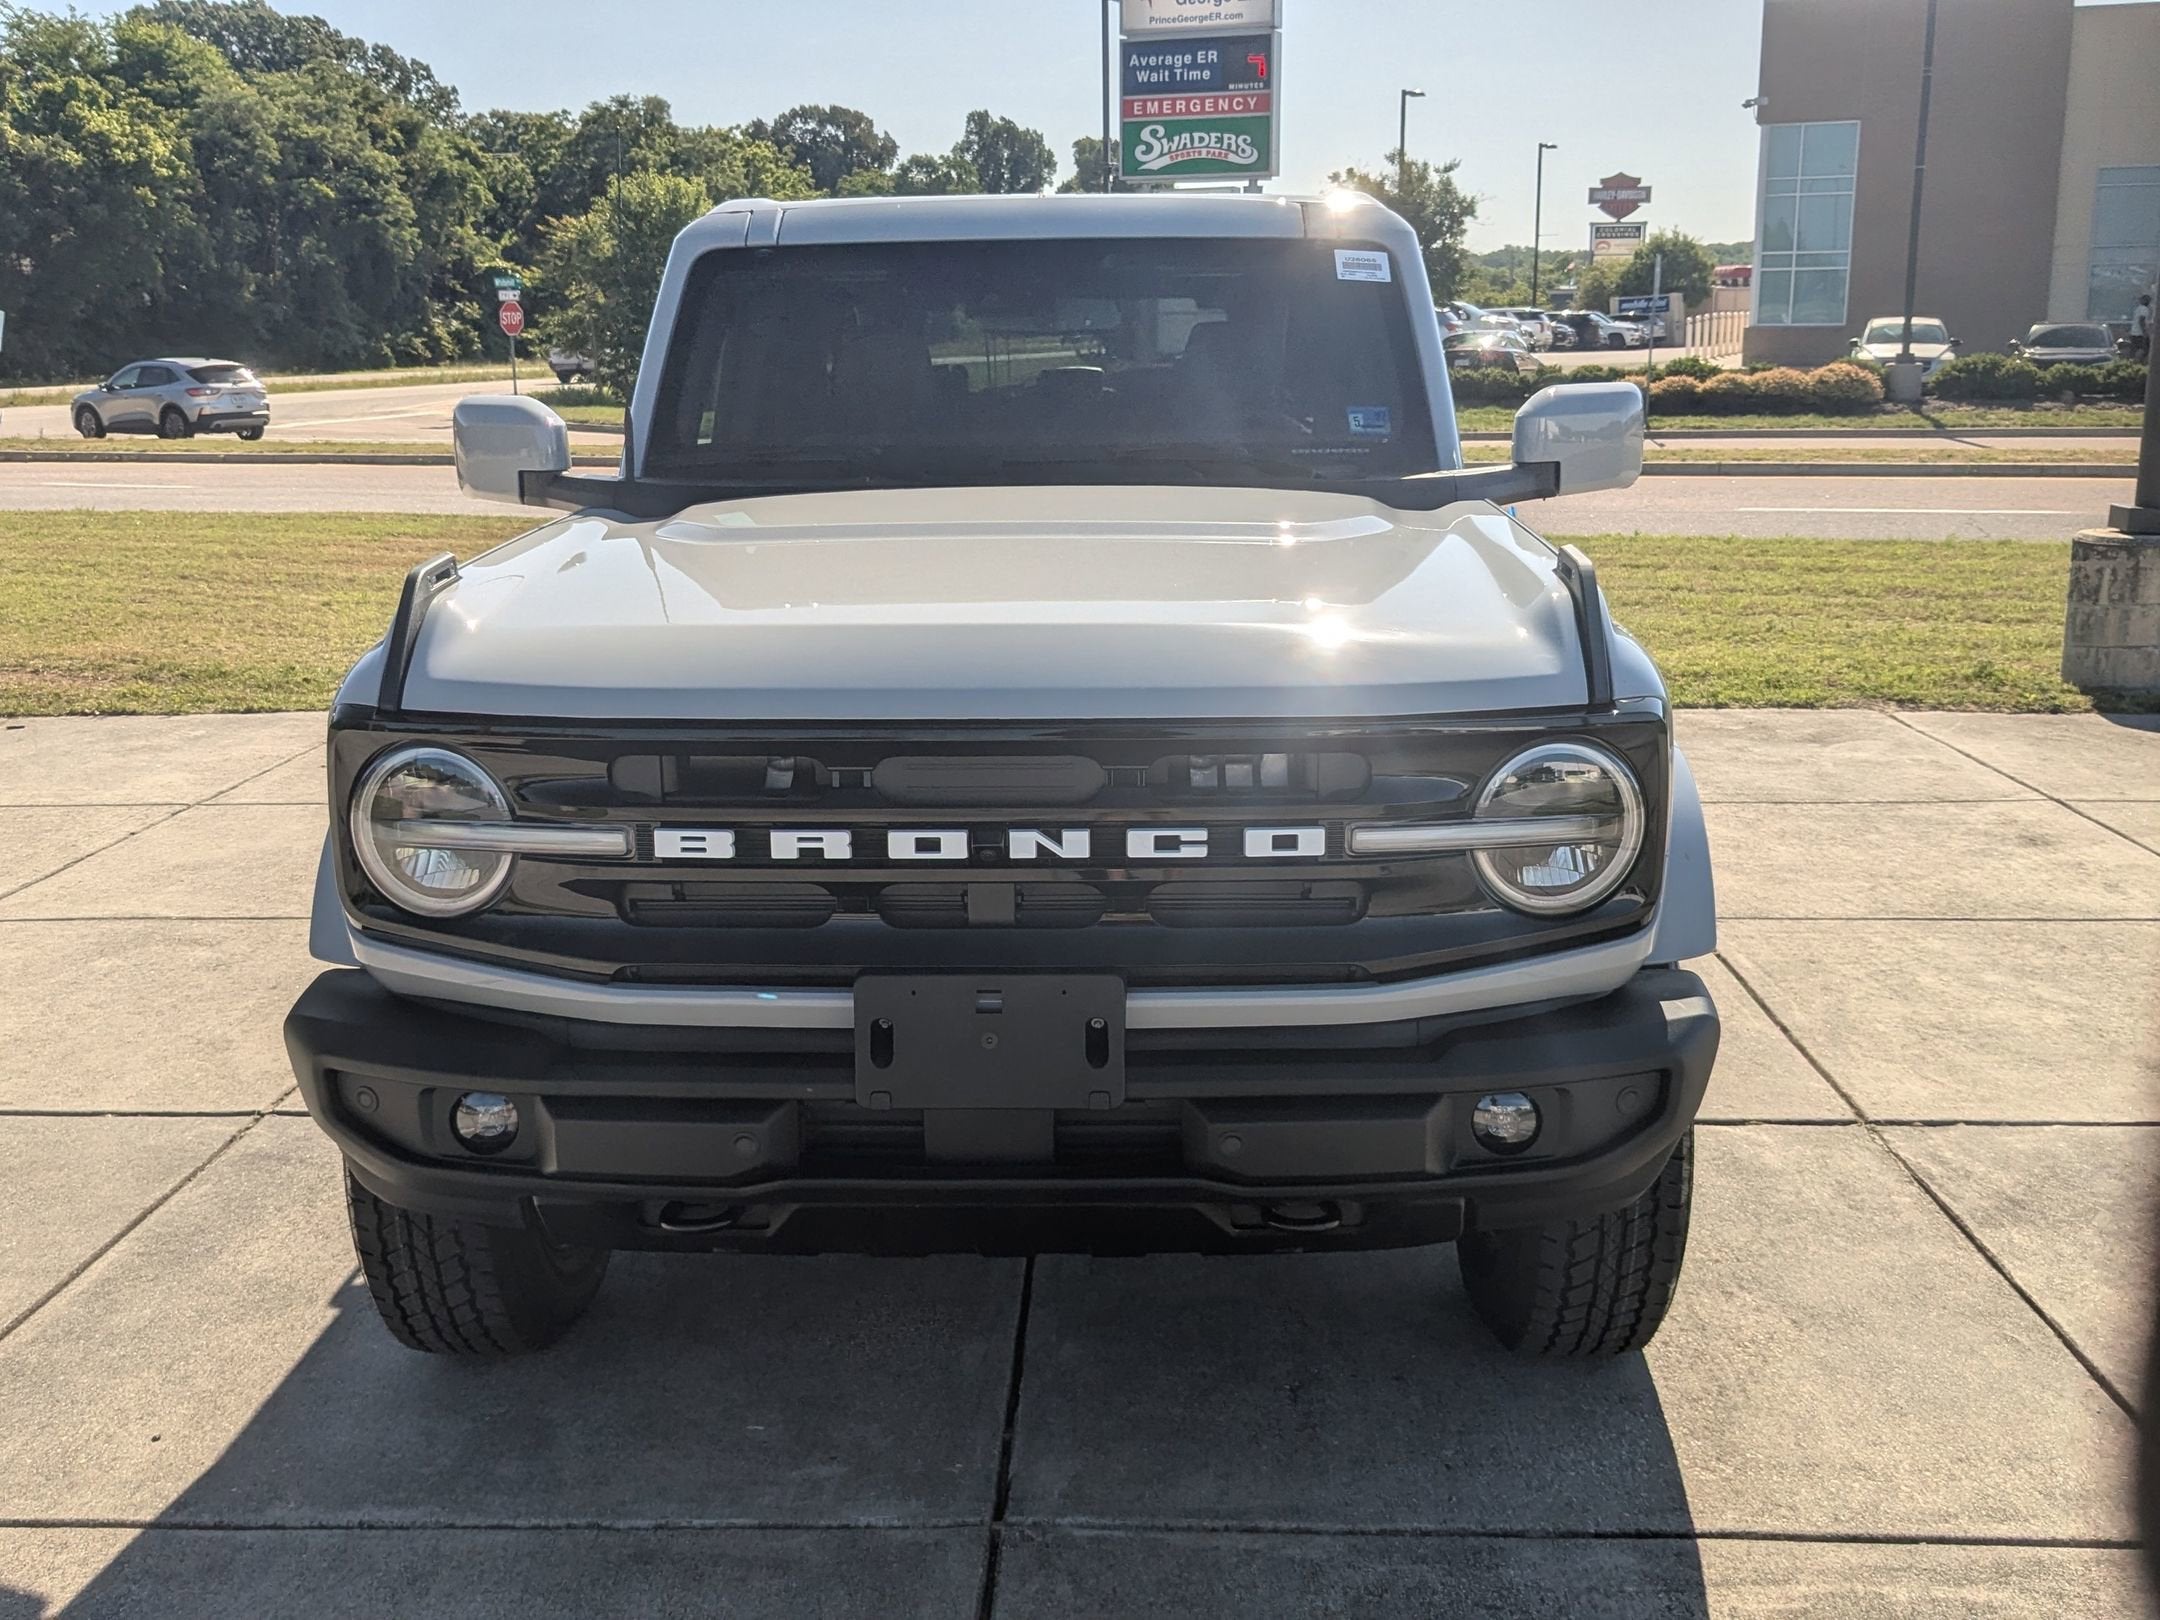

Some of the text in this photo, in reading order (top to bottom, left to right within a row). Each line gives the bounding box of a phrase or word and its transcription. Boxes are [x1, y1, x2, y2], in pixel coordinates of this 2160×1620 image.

[1149, 12, 1244, 25] PrinceGeorgeER.com
[1129, 51, 1218, 67] Average ER
[1136, 68, 1211, 83] Wait Time
[1229, 82, 1264, 90] MINUTES
[1133, 97, 1258, 115] EMERGENCY
[1169, 149, 1231, 162] SPORTS PARK
[502, 312, 522, 325] STOP
[1353, 415, 1361, 428] 5
[653, 827, 1326, 860] BRONCO
